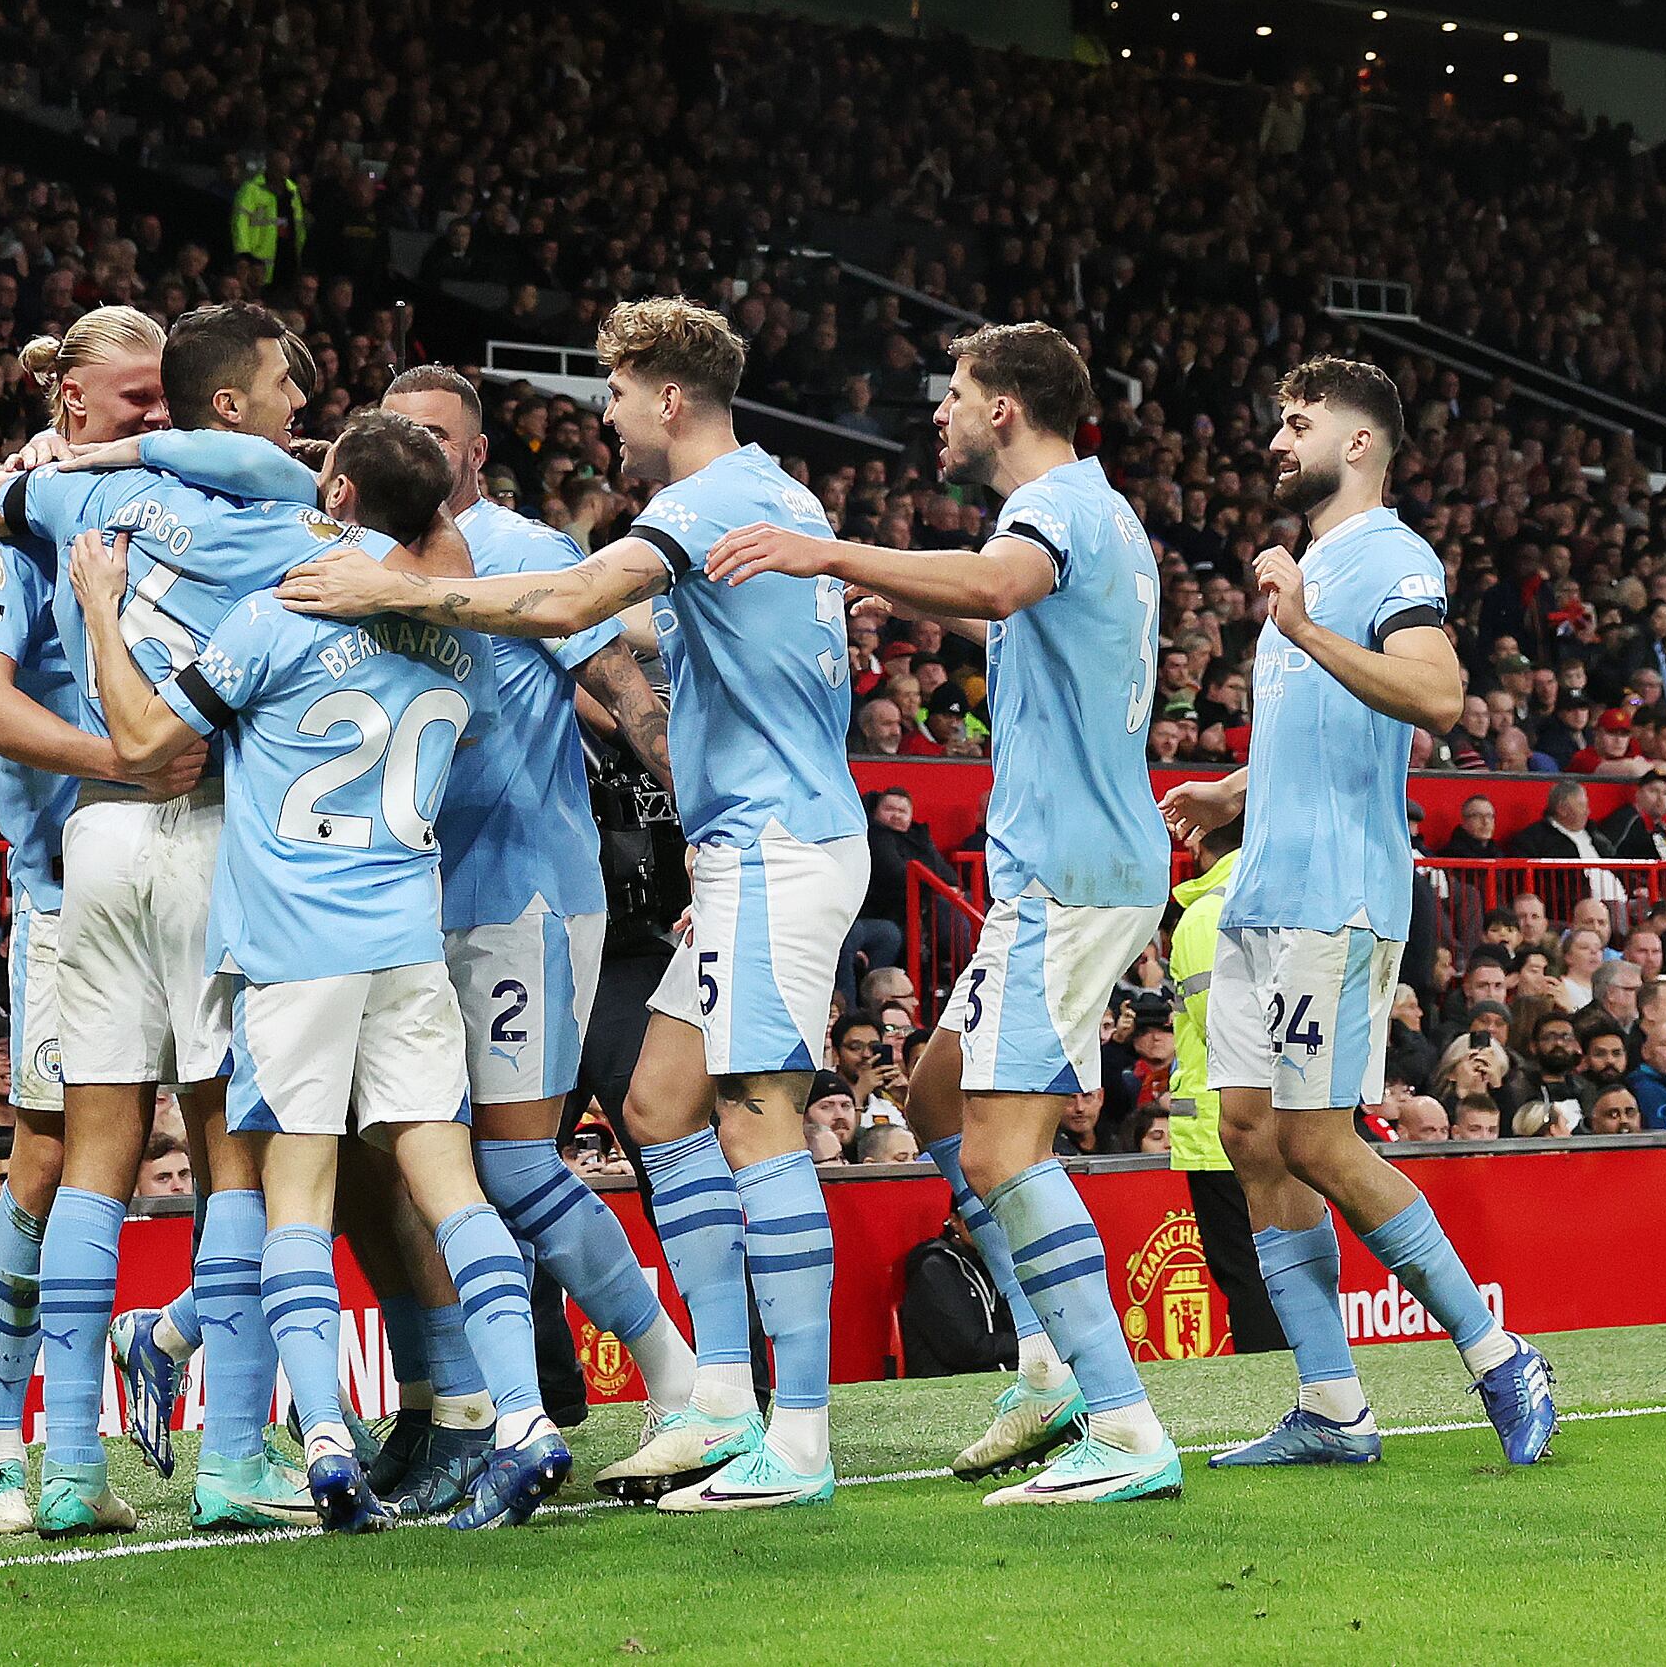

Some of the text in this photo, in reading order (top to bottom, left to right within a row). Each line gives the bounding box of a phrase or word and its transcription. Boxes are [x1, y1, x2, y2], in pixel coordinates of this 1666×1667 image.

[317, 619, 475, 682] BERNARDO
[276, 687, 471, 852] 20
[490, 979, 529, 1042] 2
[698, 951, 719, 1016] 5
[964, 968, 987, 1033] 3
[1266, 992, 1324, 1055] 24
